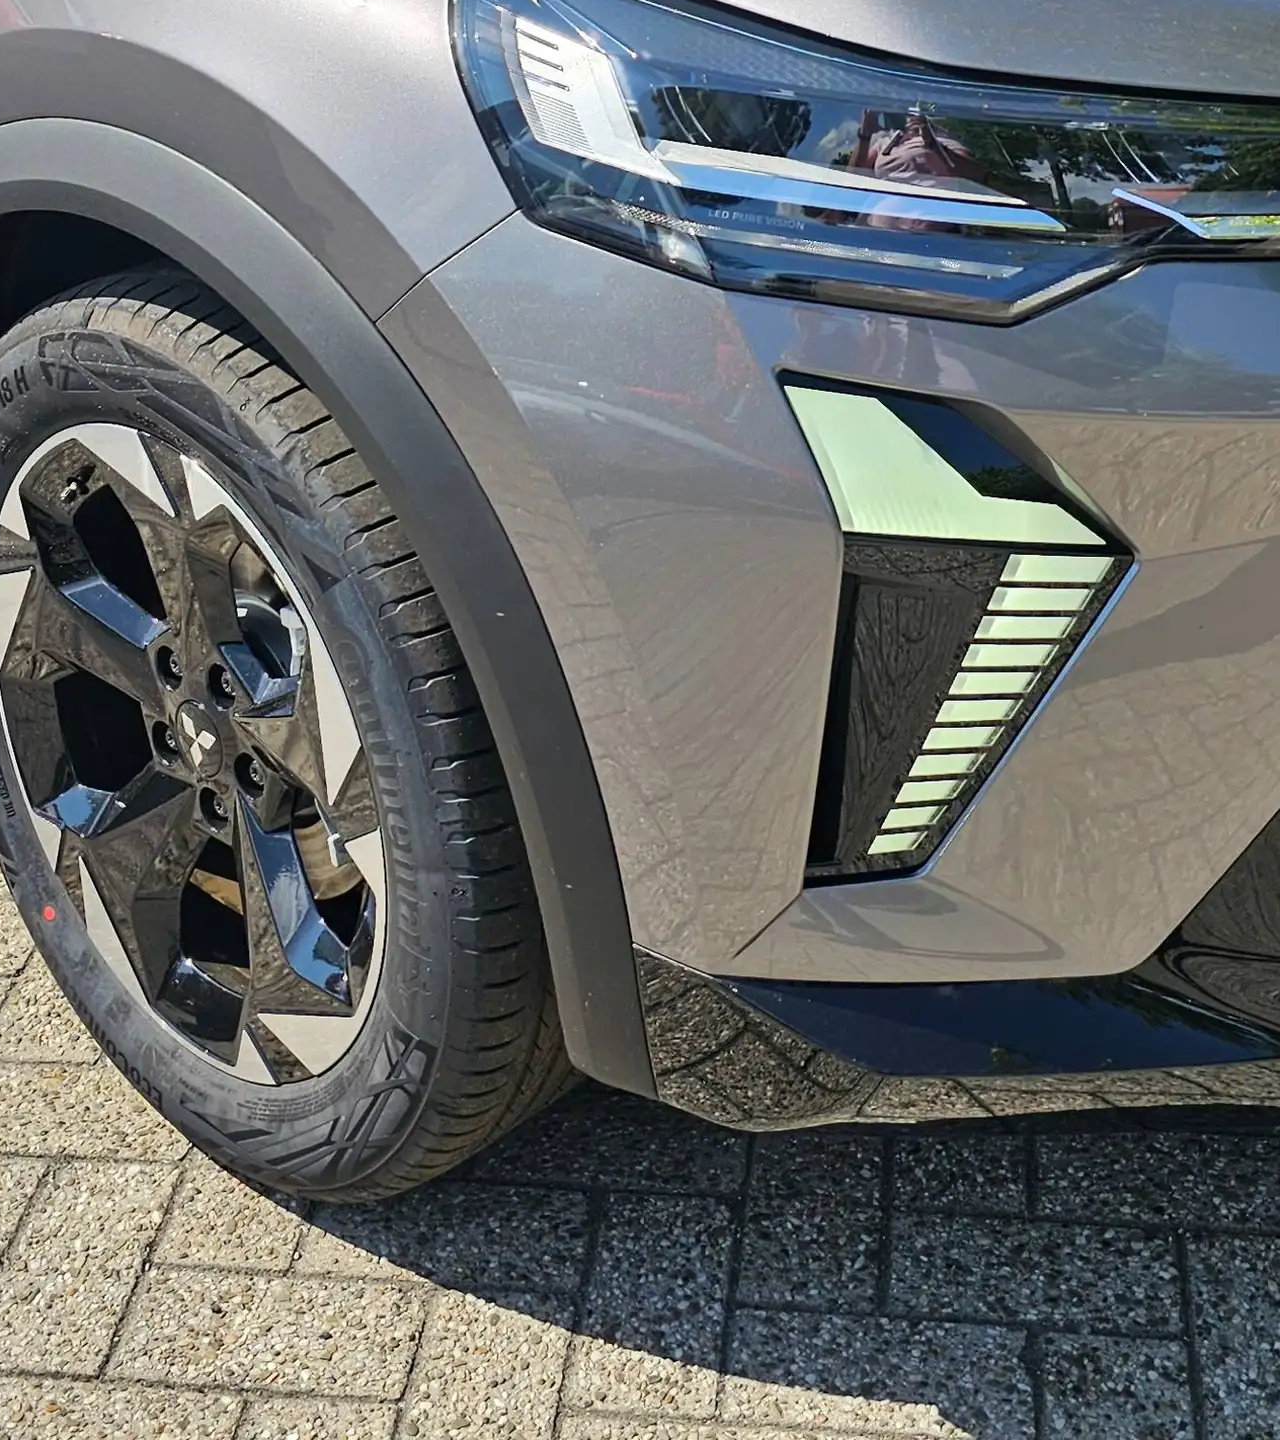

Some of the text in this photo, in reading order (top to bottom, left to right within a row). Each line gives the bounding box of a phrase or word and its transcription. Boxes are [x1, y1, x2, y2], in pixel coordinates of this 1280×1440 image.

[708, 210, 805, 230] LED PURE VISION
[14, 365, 30, 395] H
